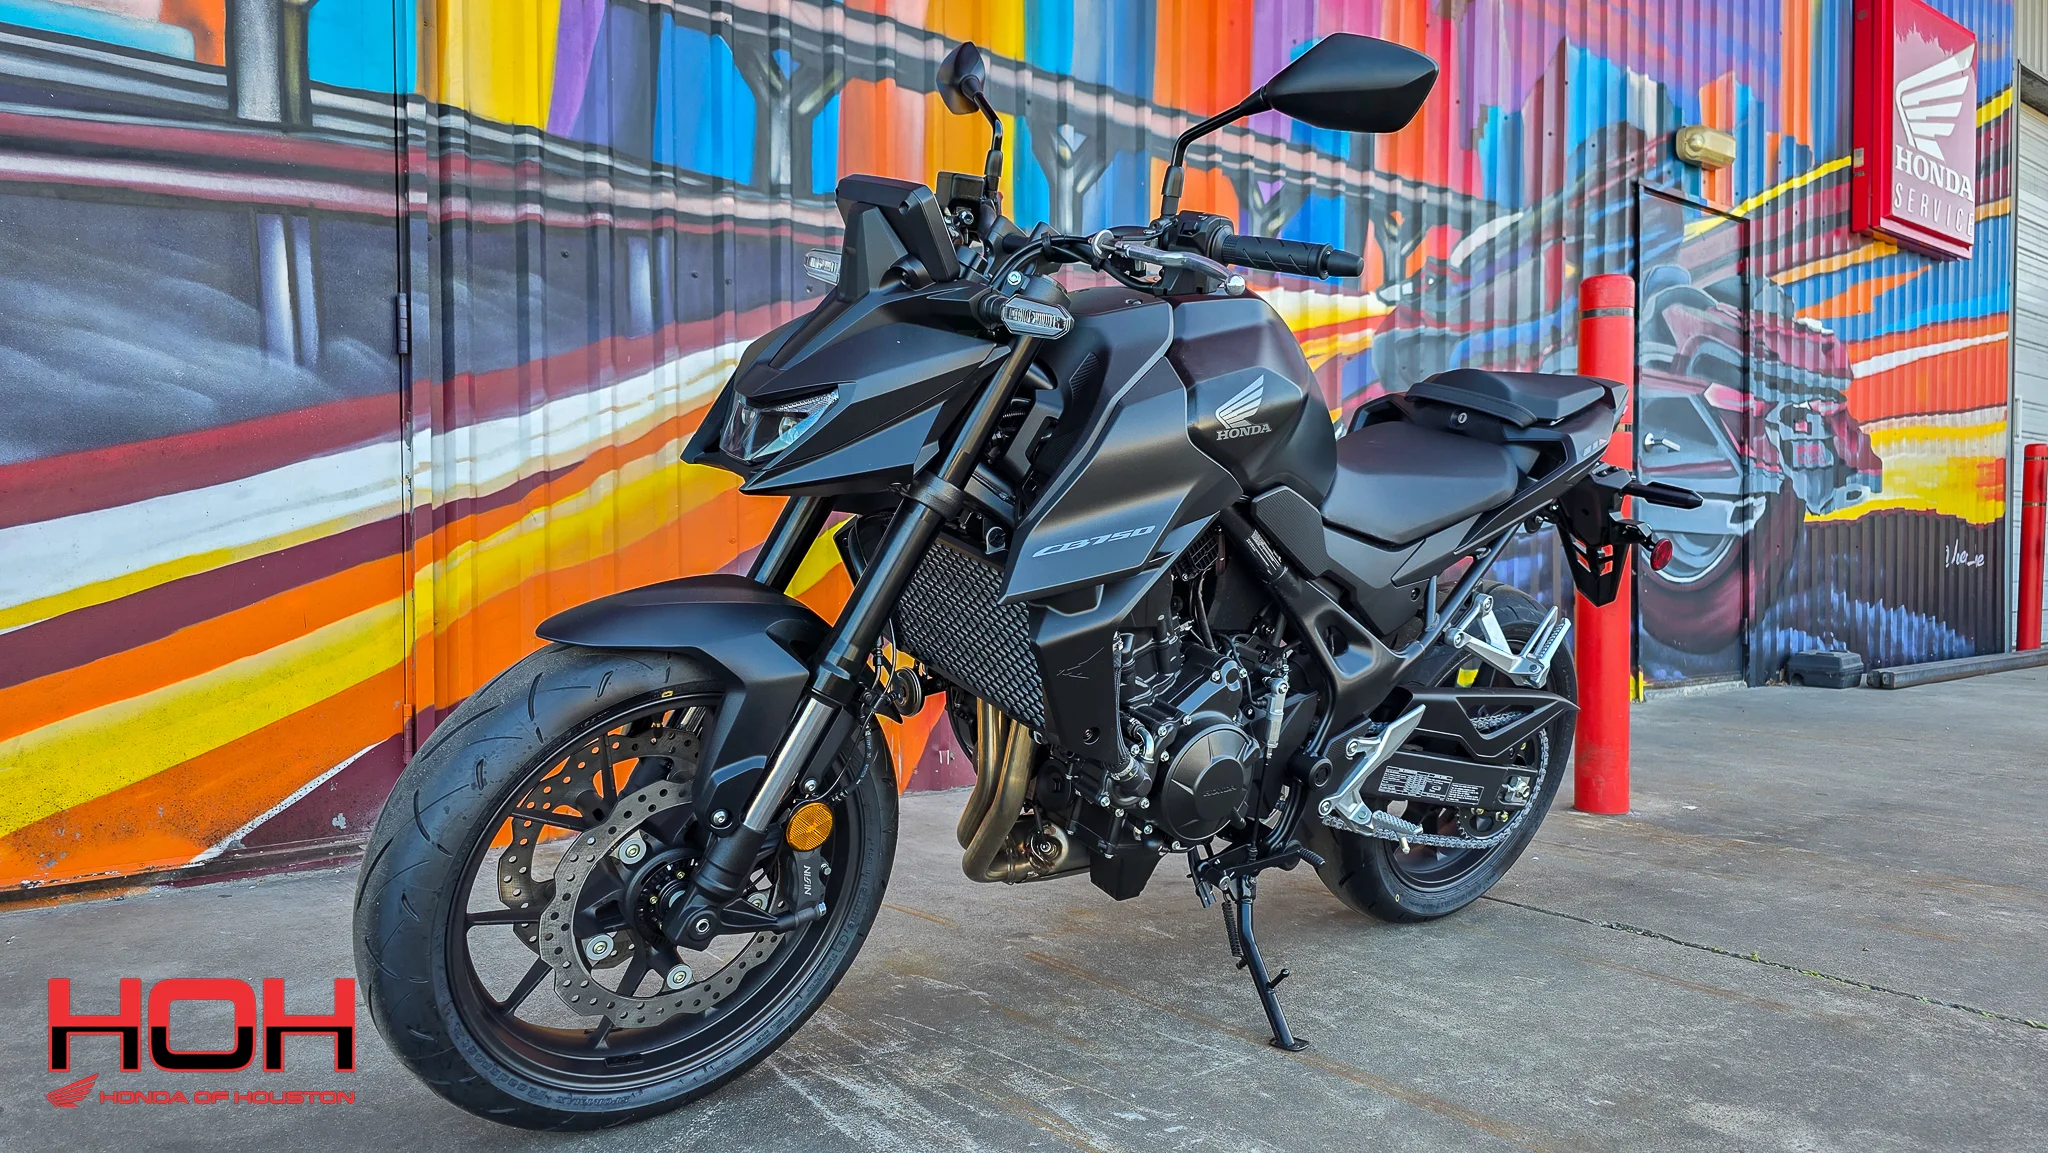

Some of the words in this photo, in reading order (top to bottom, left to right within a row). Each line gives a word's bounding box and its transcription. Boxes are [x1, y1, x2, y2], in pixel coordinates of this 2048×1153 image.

[1895, 145, 1973, 202] HONDA
[1894, 182, 1974, 237] SERVICE
[1216, 423, 1272, 441] HONDA
[1032, 525, 1156, 558] CB750
[803, 864, 812, 896] NISSIN
